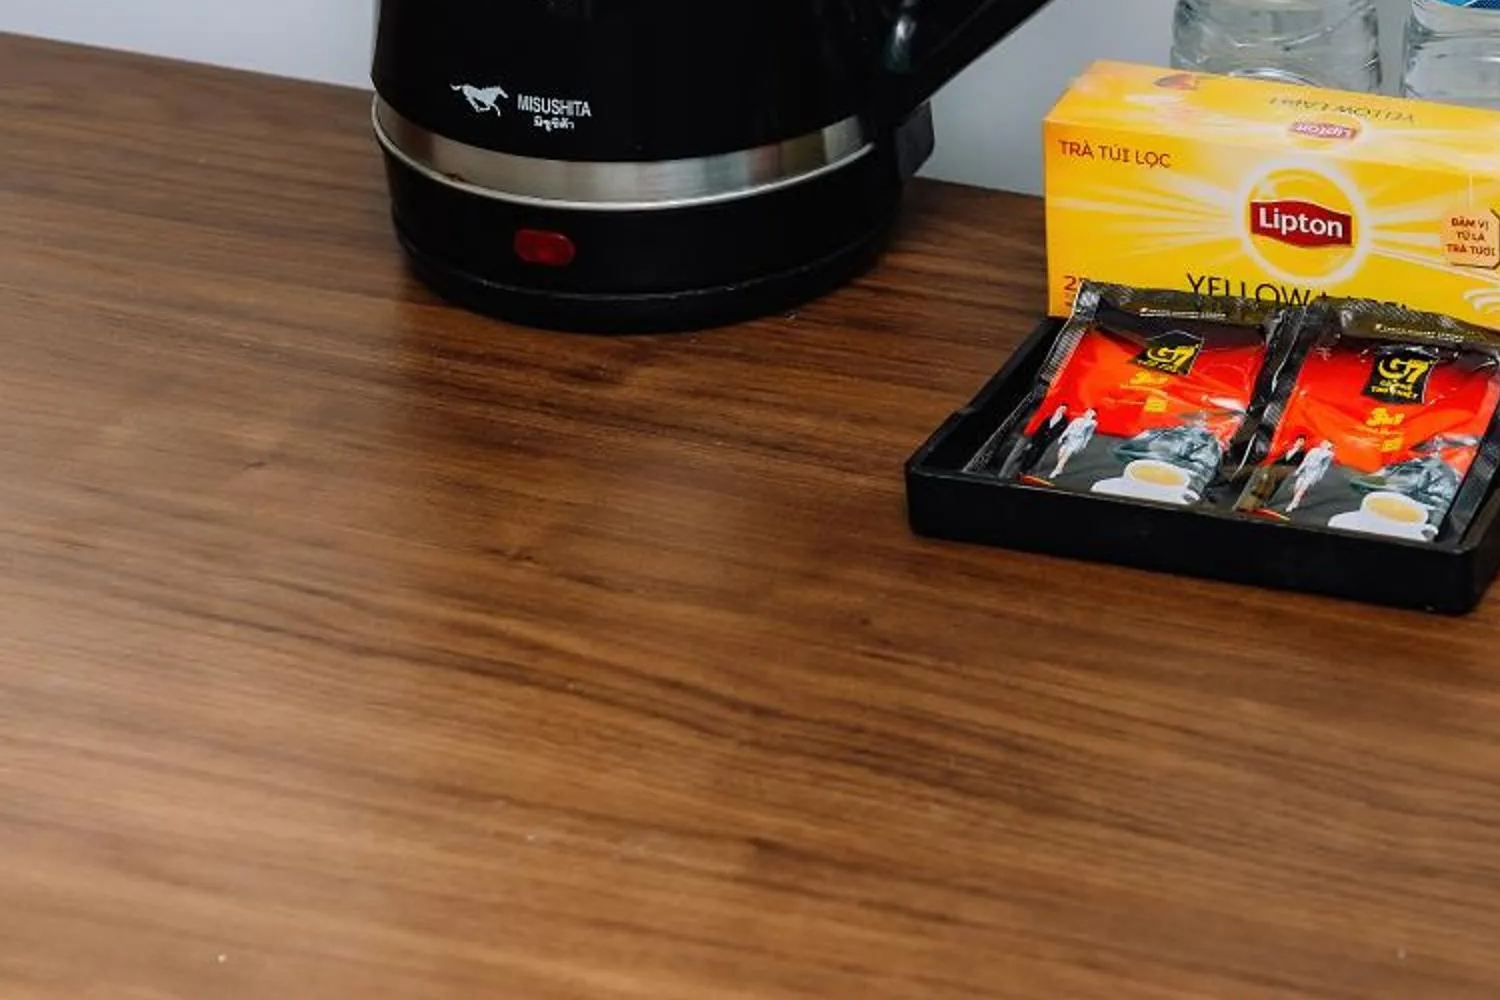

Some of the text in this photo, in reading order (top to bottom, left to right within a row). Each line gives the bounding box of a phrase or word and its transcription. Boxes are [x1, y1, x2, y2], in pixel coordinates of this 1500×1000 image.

[517, 93, 592, 117] MISUSHITA
[1296, 122, 1351, 139] Lipton
[1058, 139, 1170, 168] TRÀ TÚI LỌC
[1259, 206, 1344, 239] Lipton
[1147, 346, 1197, 372] G7
[1378, 358, 1430, 384] G7
